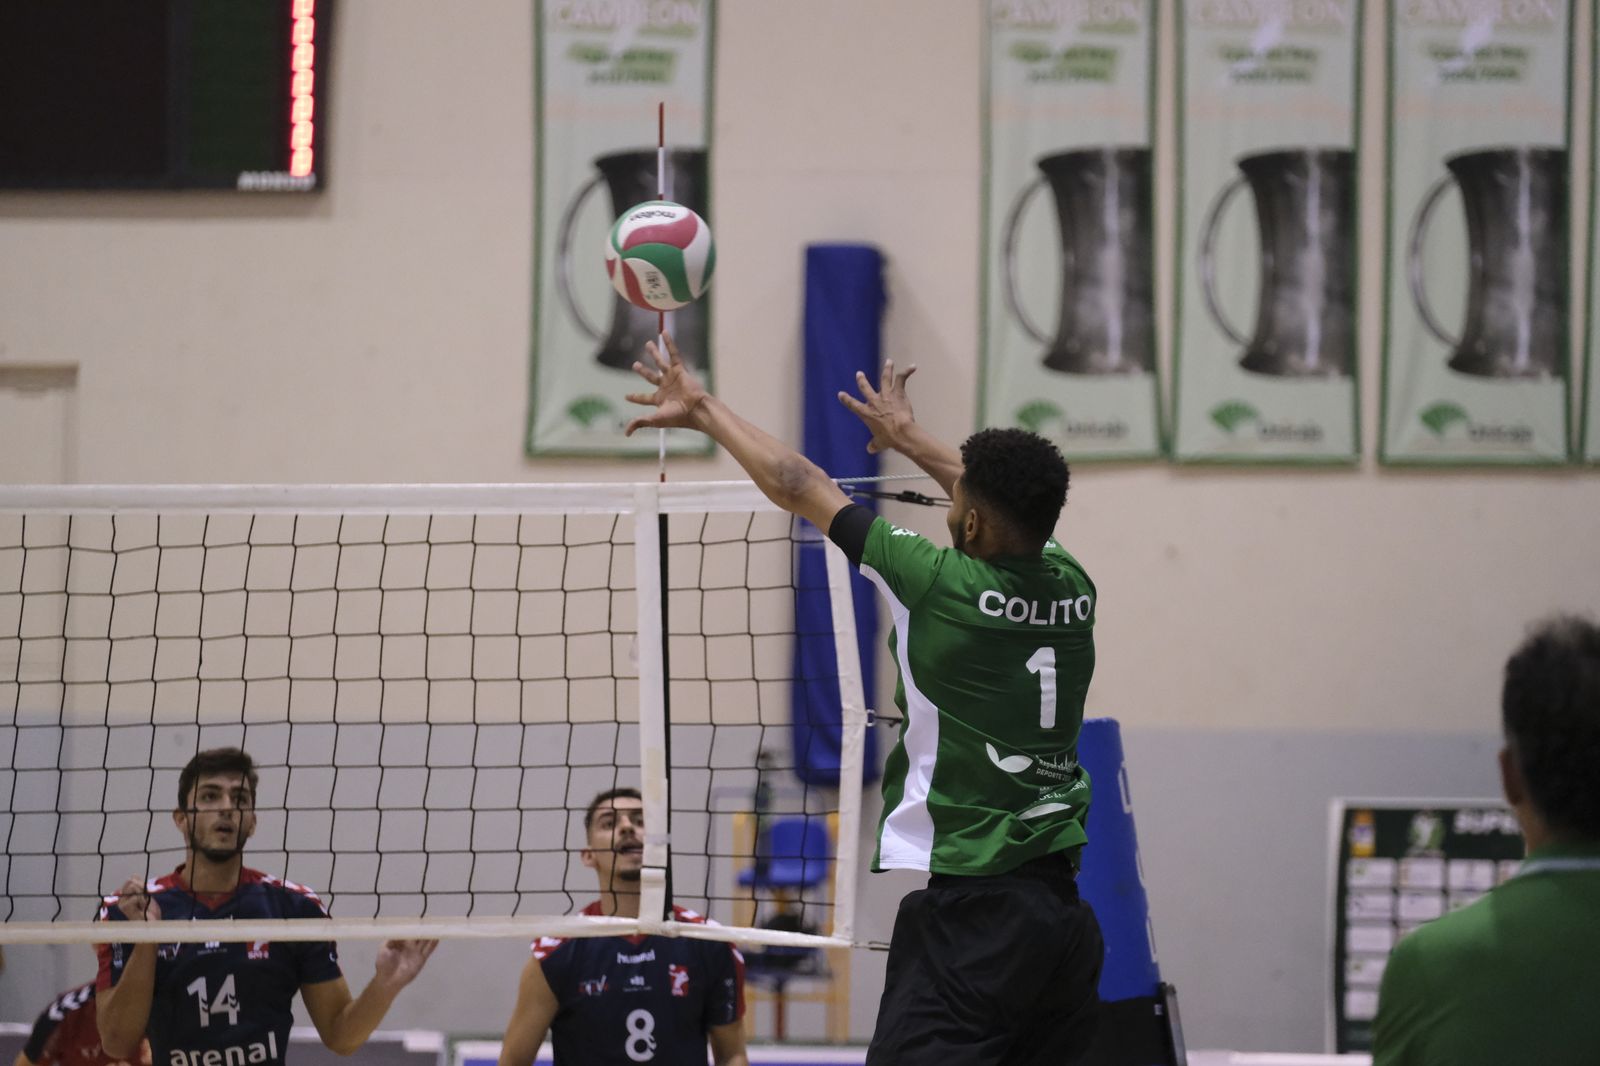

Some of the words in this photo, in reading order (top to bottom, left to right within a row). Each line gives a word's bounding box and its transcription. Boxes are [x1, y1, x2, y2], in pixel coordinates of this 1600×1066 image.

[978, 589, 1092, 626] COLITO
[1025, 646, 1057, 729] 1
[186, 973, 241, 1028] 14
[169, 1030, 279, 1066] arenal
[624, 1008, 657, 1062] 8
